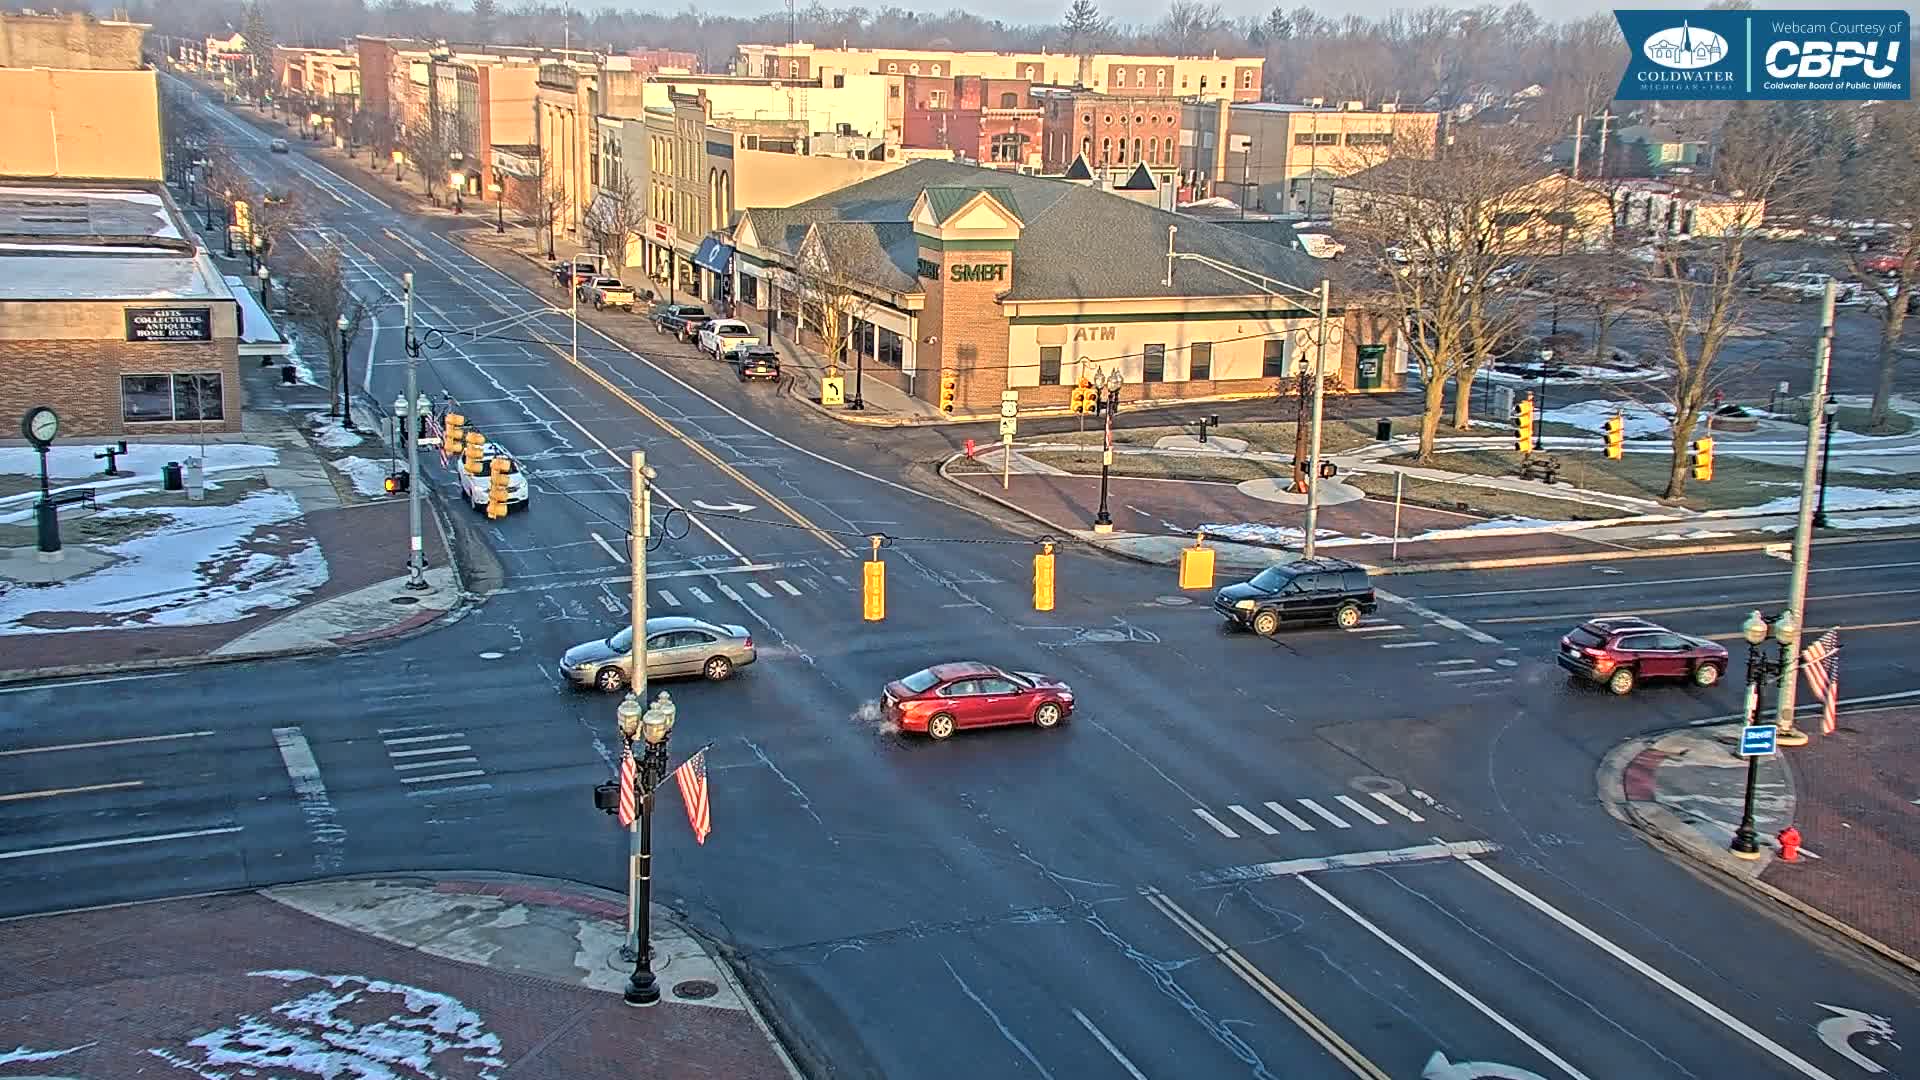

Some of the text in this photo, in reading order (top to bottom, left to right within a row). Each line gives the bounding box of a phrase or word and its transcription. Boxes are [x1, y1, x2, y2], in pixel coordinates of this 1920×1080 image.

[950, 263, 1008, 282] SMBT
[134, 316, 203, 324] COLLECTIBLES
[1073, 326, 1116, 342] ATM
